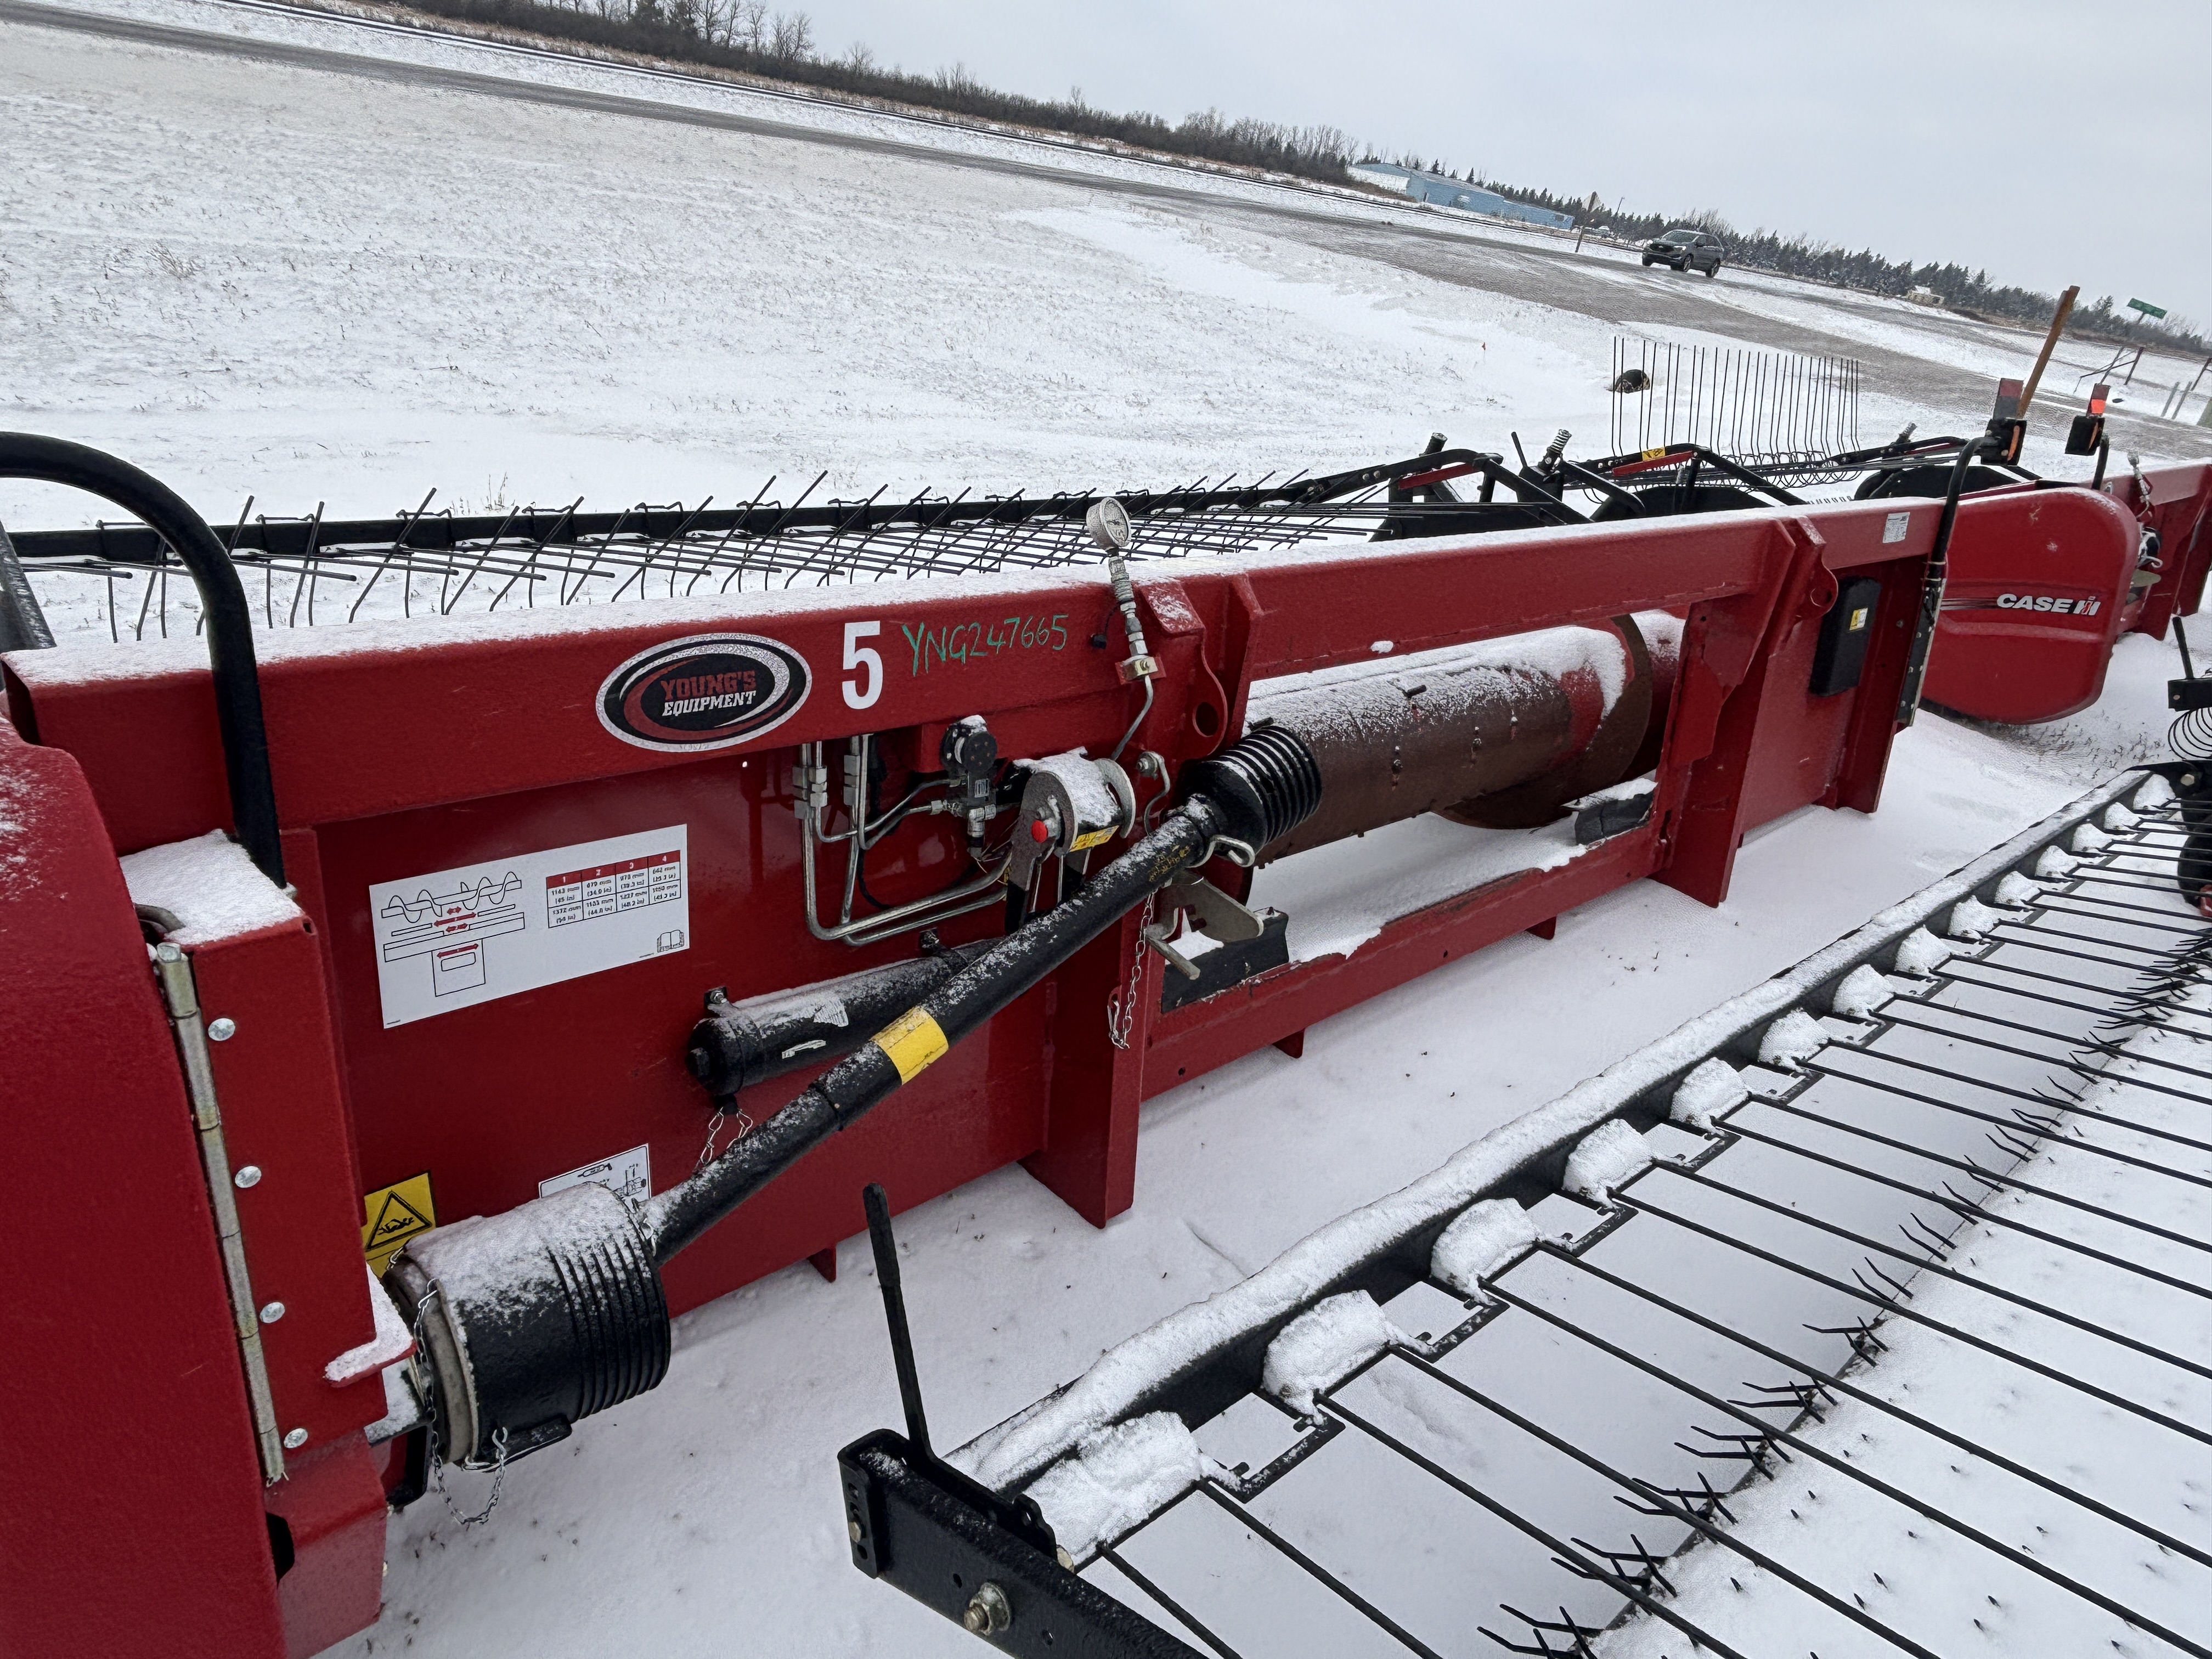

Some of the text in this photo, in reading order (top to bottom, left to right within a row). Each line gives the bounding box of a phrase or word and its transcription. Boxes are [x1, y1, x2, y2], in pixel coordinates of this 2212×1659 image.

[1997, 594, 2073, 613] CASE
[901, 614, 1069, 677] YNG247665
[842, 620, 883, 709] 5
[660, 670, 757, 701] YOUNG'S
[662, 690, 757, 716] EQUIPMENT
